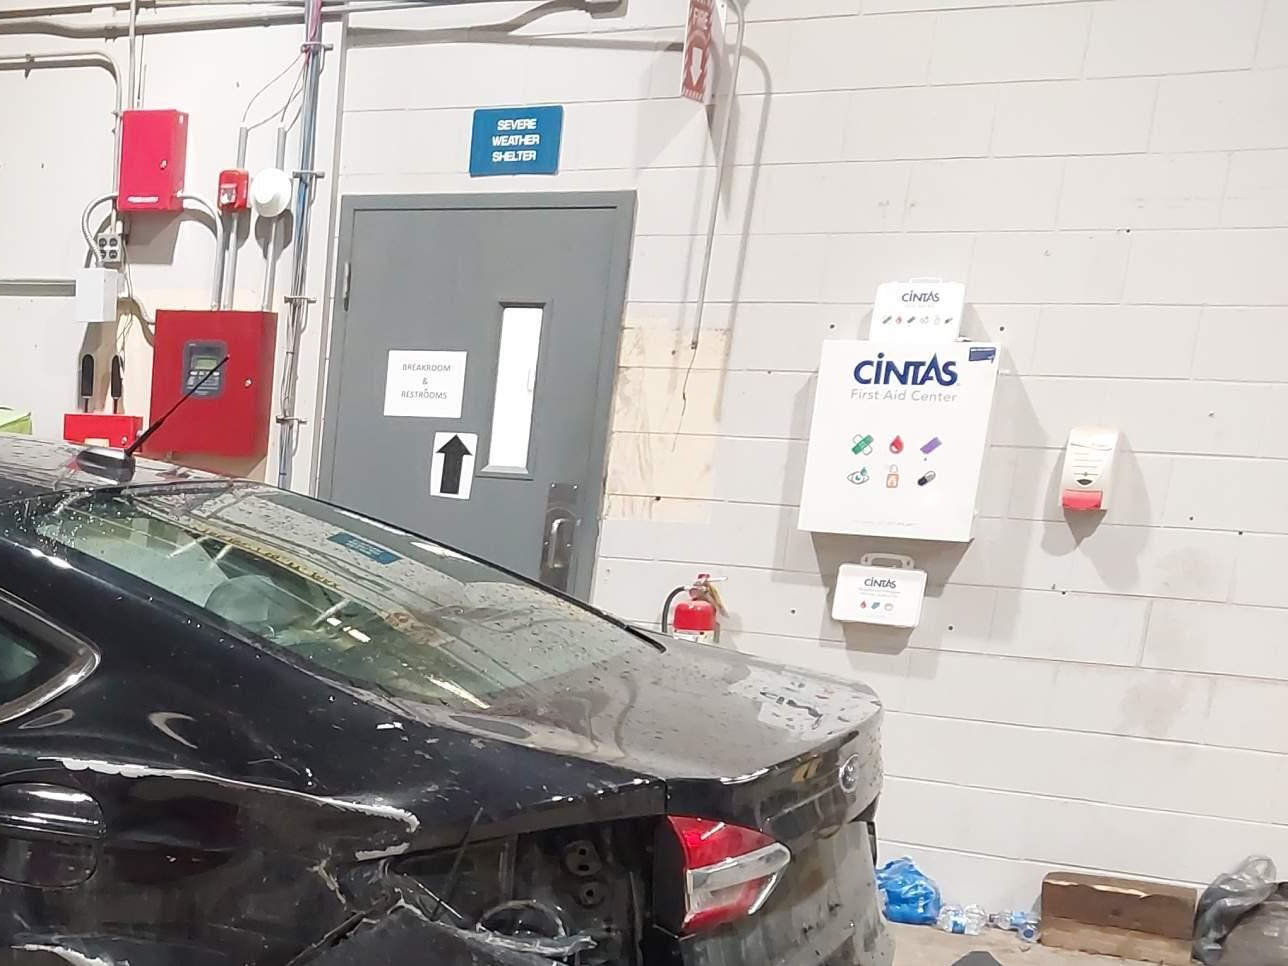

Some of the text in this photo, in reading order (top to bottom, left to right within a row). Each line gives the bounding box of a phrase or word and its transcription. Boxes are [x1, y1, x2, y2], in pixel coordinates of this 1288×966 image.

[497, 118, 537, 131] SEVERE
[492, 134, 540, 147] WEATHER
[492, 150, 537, 162] SHELTER
[402, 363, 451, 372] BREAKROOM
[400, 390, 448, 400] RESTROOMS
[851, 388, 958, 403] First Aid Center
